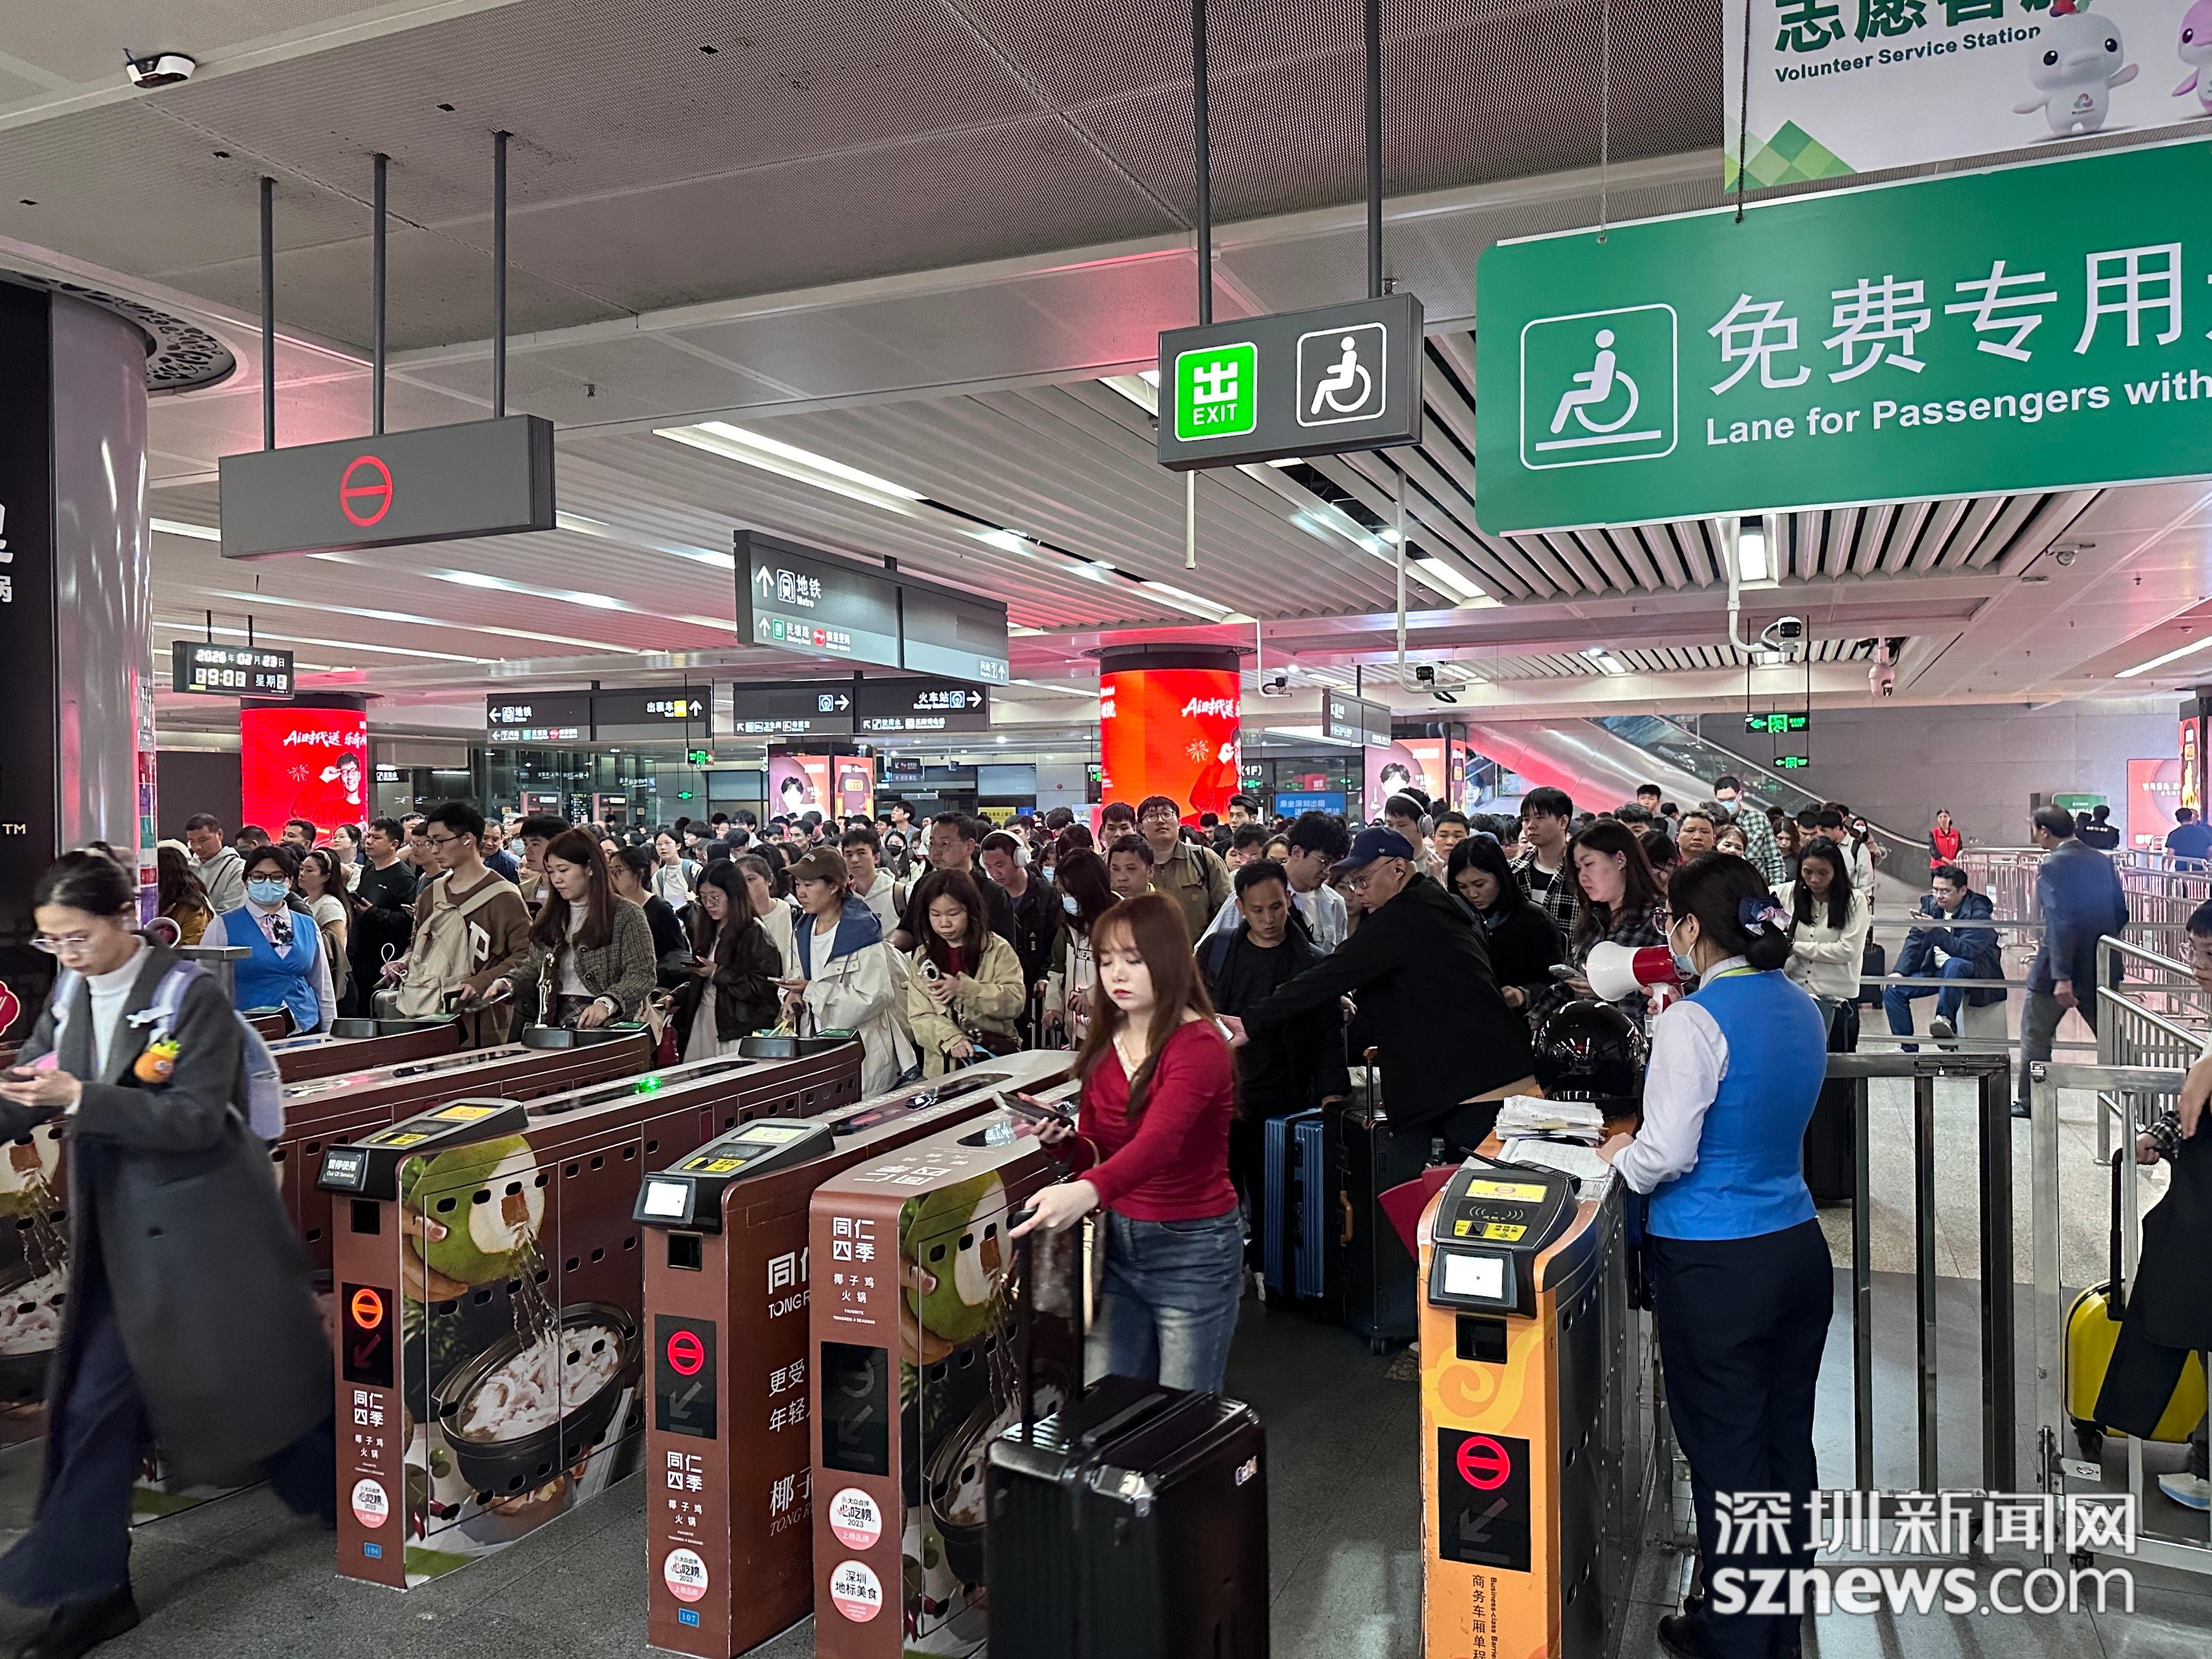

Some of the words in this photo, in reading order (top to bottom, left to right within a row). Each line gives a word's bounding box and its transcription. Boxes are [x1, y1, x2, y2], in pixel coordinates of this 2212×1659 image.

[1775, 0, 2053, 53] 志愿
[1775, 55, 1873, 82] Volunteer
[1878, 39, 1957, 65] Service
[1963, 25, 2041, 50] Station
[1707, 242, 2212, 395] 免费专用
[1193, 361, 1238, 405] 出
[1192, 403, 1238, 426] EXIT
[1707, 417, 1795, 445] Lane
[1806, 407, 1860, 436] for
[1873, 385, 2110, 429] Passengers
[2124, 369, 2212, 405] with
[796, 574, 821, 599] 地铁
[918, 691, 949, 703] 火车站
[2, 824, 27, 835] TM
[833, 1217, 875, 1240] 同仁
[833, 1240, 875, 1263] 四季
[833, 1273, 875, 1288] 椰子鸡
[841, 1290, 867, 1303] 火锅
[769, 1358, 805, 1398] 更受
[354, 1390, 384, 1410] 同仁
[354, 1408, 384, 1427] 四季
[769, 1397, 810, 1432] 年轻
[355, 1434, 384, 1448] 椰子鸡
[360, 1448, 378, 1459] 火锅
[667, 1451, 703, 1473] 同仁
[667, 1471, 703, 1493] 四季
[668, 1499, 703, 1515] 椰子鸡
[848, 1497, 869, 1507] 大众点评
[675, 1514, 696, 1527] 火锅
[837, 1504, 872, 1521] 必吃榜
[848, 1519, 864, 1528] 2023
[845, 1569, 867, 1585] 深圳
[835, 1580, 877, 1601] 地标美食
[682, 1613, 696, 1622] 107
[1472, 1574, 1486, 1659] 商务车厢单程
